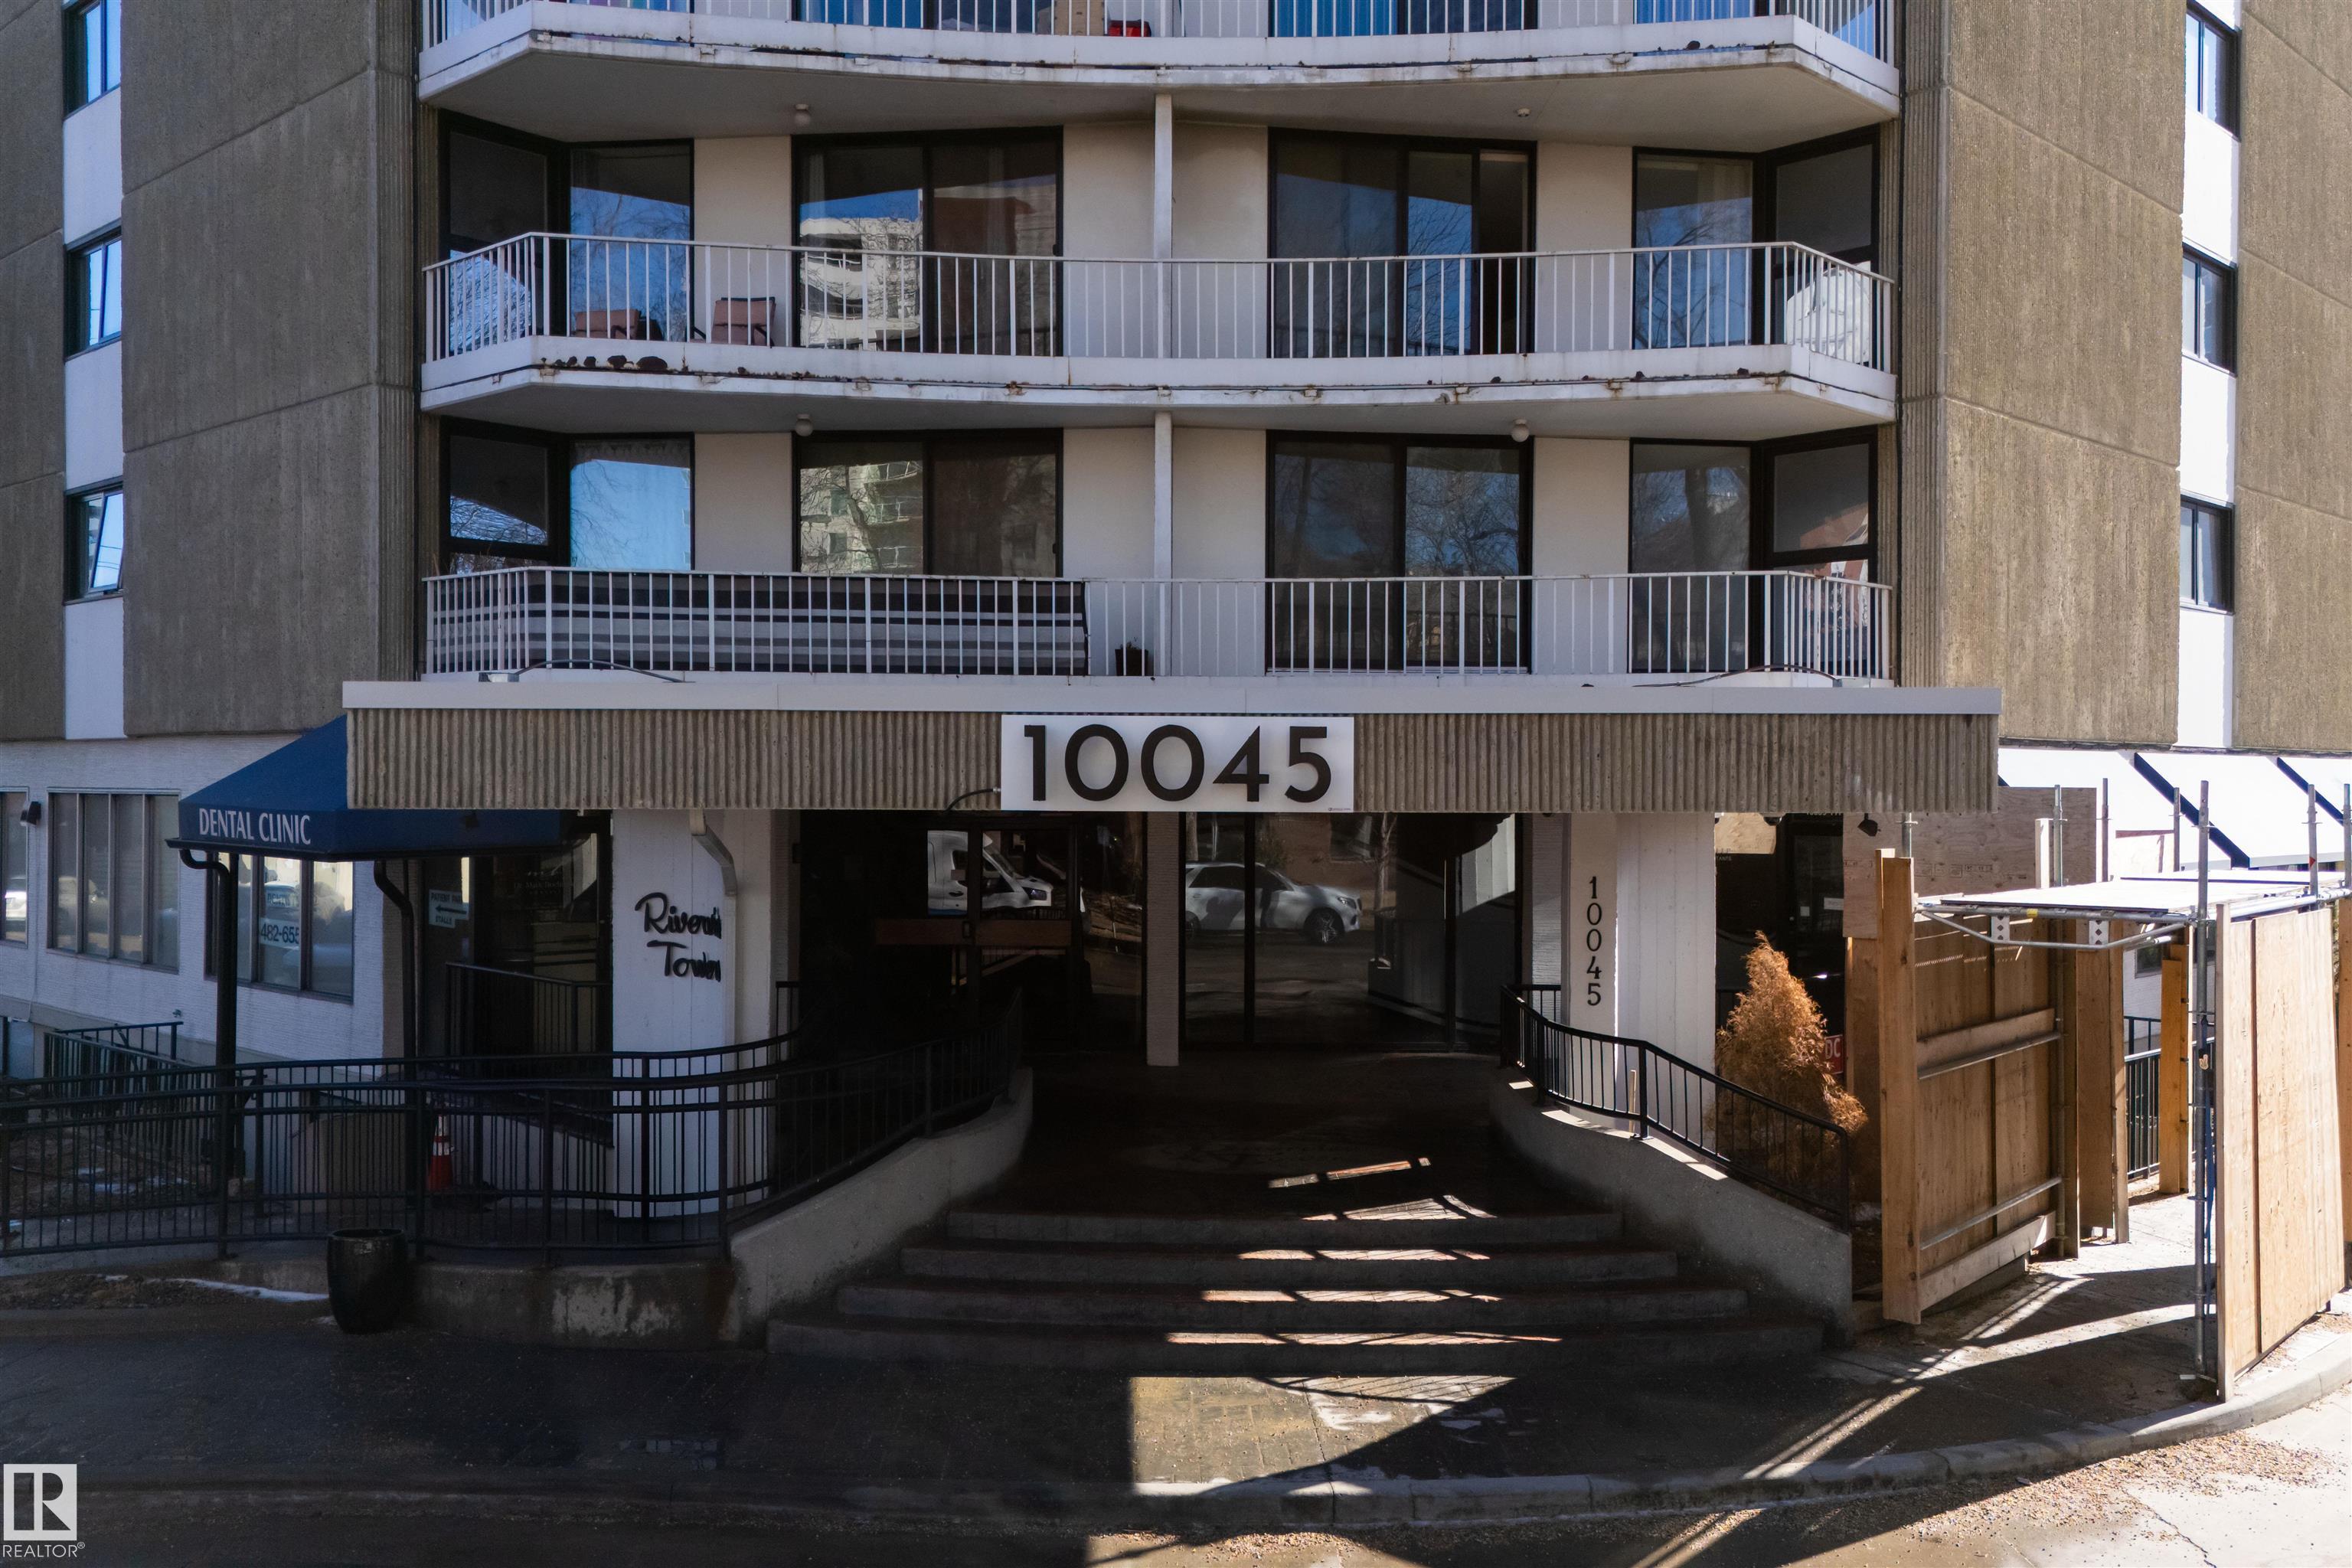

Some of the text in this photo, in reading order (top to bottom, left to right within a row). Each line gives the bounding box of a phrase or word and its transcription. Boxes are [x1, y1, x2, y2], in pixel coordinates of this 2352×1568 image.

[1024, 724, 1331, 802] 10045
[198, 808, 311, 845] DENTAL CLINIC
[1586, 876, 1602, 1006] 10045
